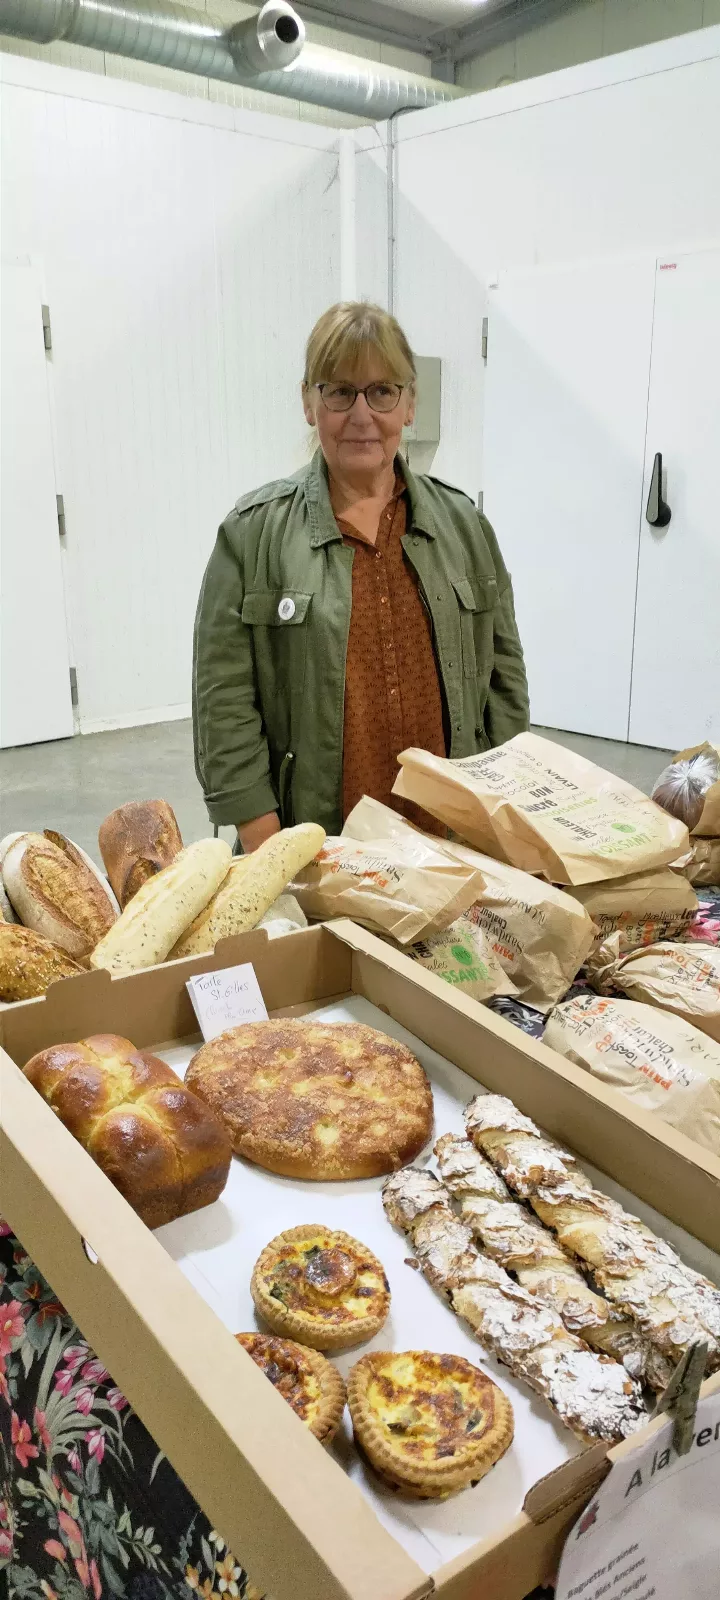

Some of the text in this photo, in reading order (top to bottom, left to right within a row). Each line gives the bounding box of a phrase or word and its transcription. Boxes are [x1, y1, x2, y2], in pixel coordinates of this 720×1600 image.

[544, 768, 579, 791] LEVAIN
[529, 786, 555, 799] BON
[553, 817, 598, 840] CHALEUR
[479, 906, 508, 931] Chaleur
[491, 943, 516, 961] PAIN
[604, 1041, 638, 1068] Toast
[638, 1064, 673, 1091] PAIN
[624, 1447, 671, 1499] A la
